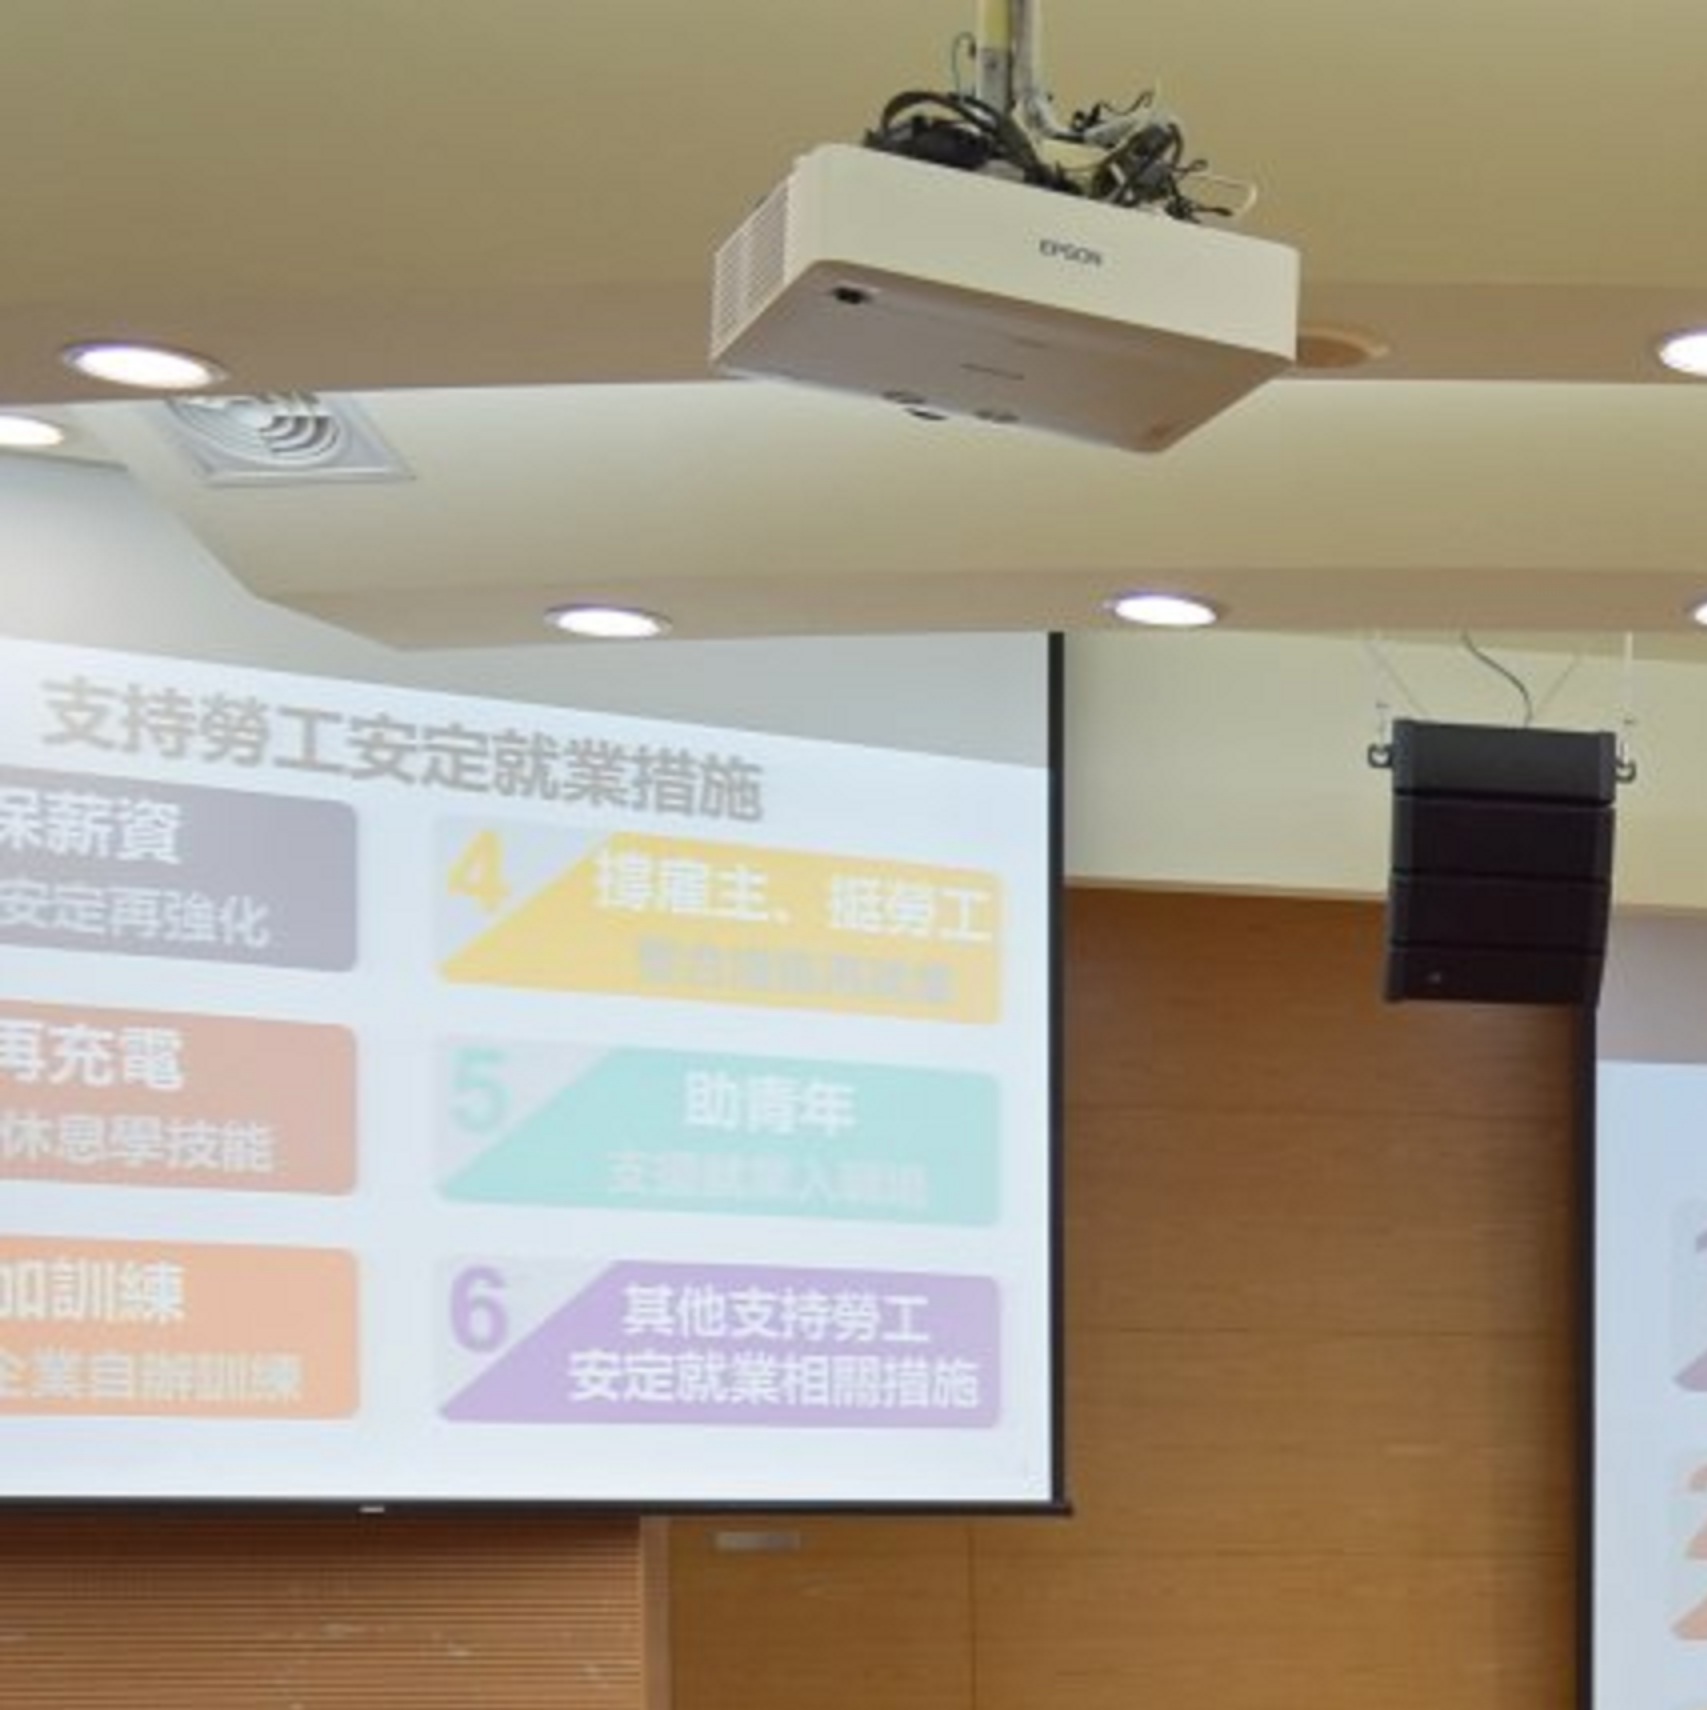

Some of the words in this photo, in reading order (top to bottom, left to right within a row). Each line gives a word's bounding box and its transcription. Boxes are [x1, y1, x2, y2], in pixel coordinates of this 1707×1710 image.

[1039, 239, 1102, 265] EPSON
[40, 674, 764, 822] 支持勞工安定就業措施
[446, 829, 509, 912] 4
[449, 1046, 510, 1133] 5
[683, 1070, 856, 1137] 助青年
[450, 1264, 508, 1354] 6
[623, 1284, 931, 1344] 其他支持勞工
[568, 1350, 980, 1409] 安定就業相關措施
